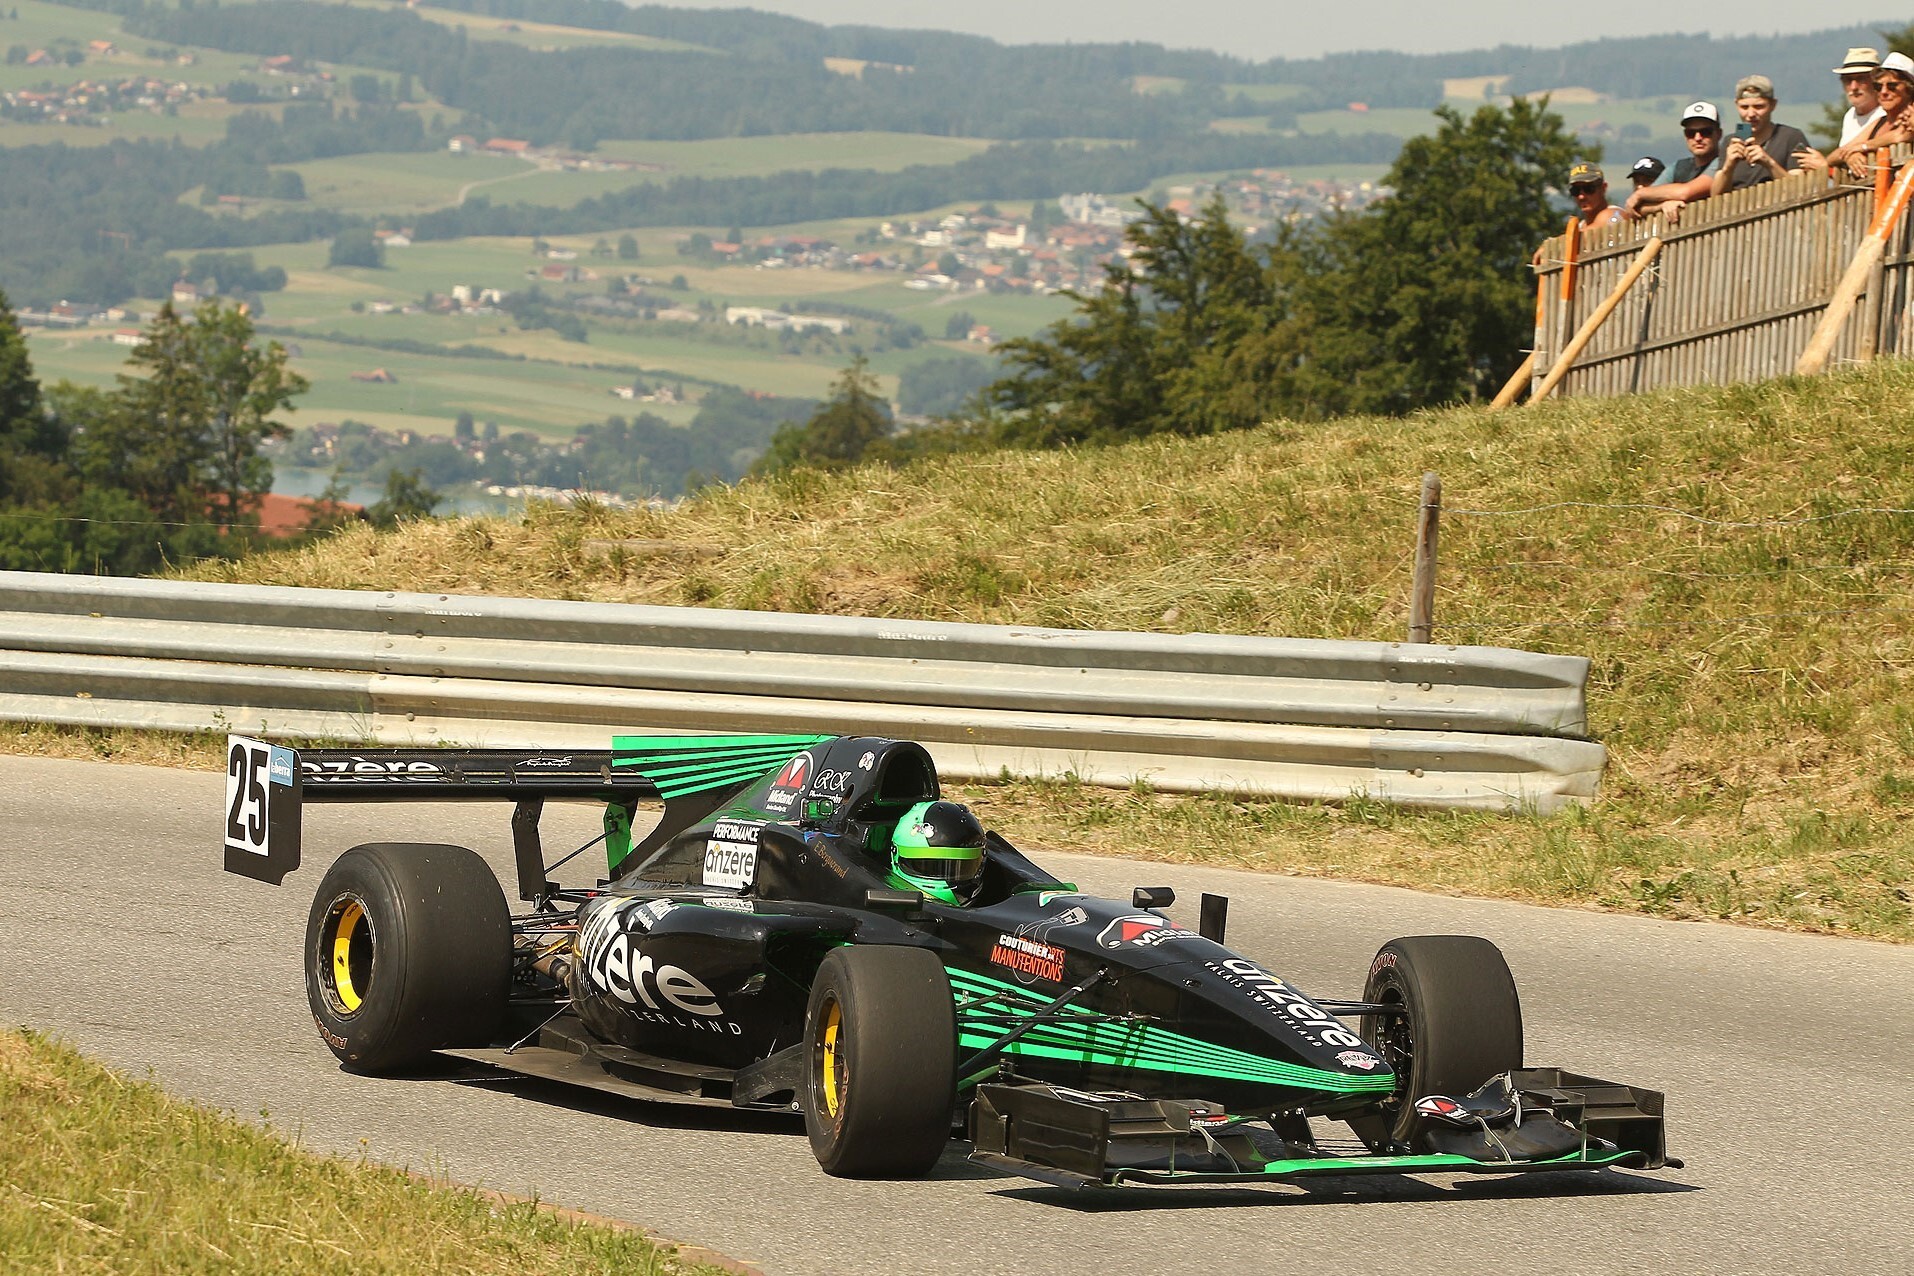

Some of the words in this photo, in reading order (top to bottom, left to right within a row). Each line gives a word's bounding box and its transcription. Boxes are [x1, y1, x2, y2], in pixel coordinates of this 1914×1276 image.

[228, 743, 268, 846] 25
[713, 824, 760, 842] PERFORMANCE
[705, 845, 754, 877] anzère
[999, 934, 1048, 958] COUTURIER
[991, 945, 1063, 982] MANUTENTIONS
[1203, 960, 1245, 989] VALAIS
[1246, 989, 1324, 1048] SWITZERLAND
